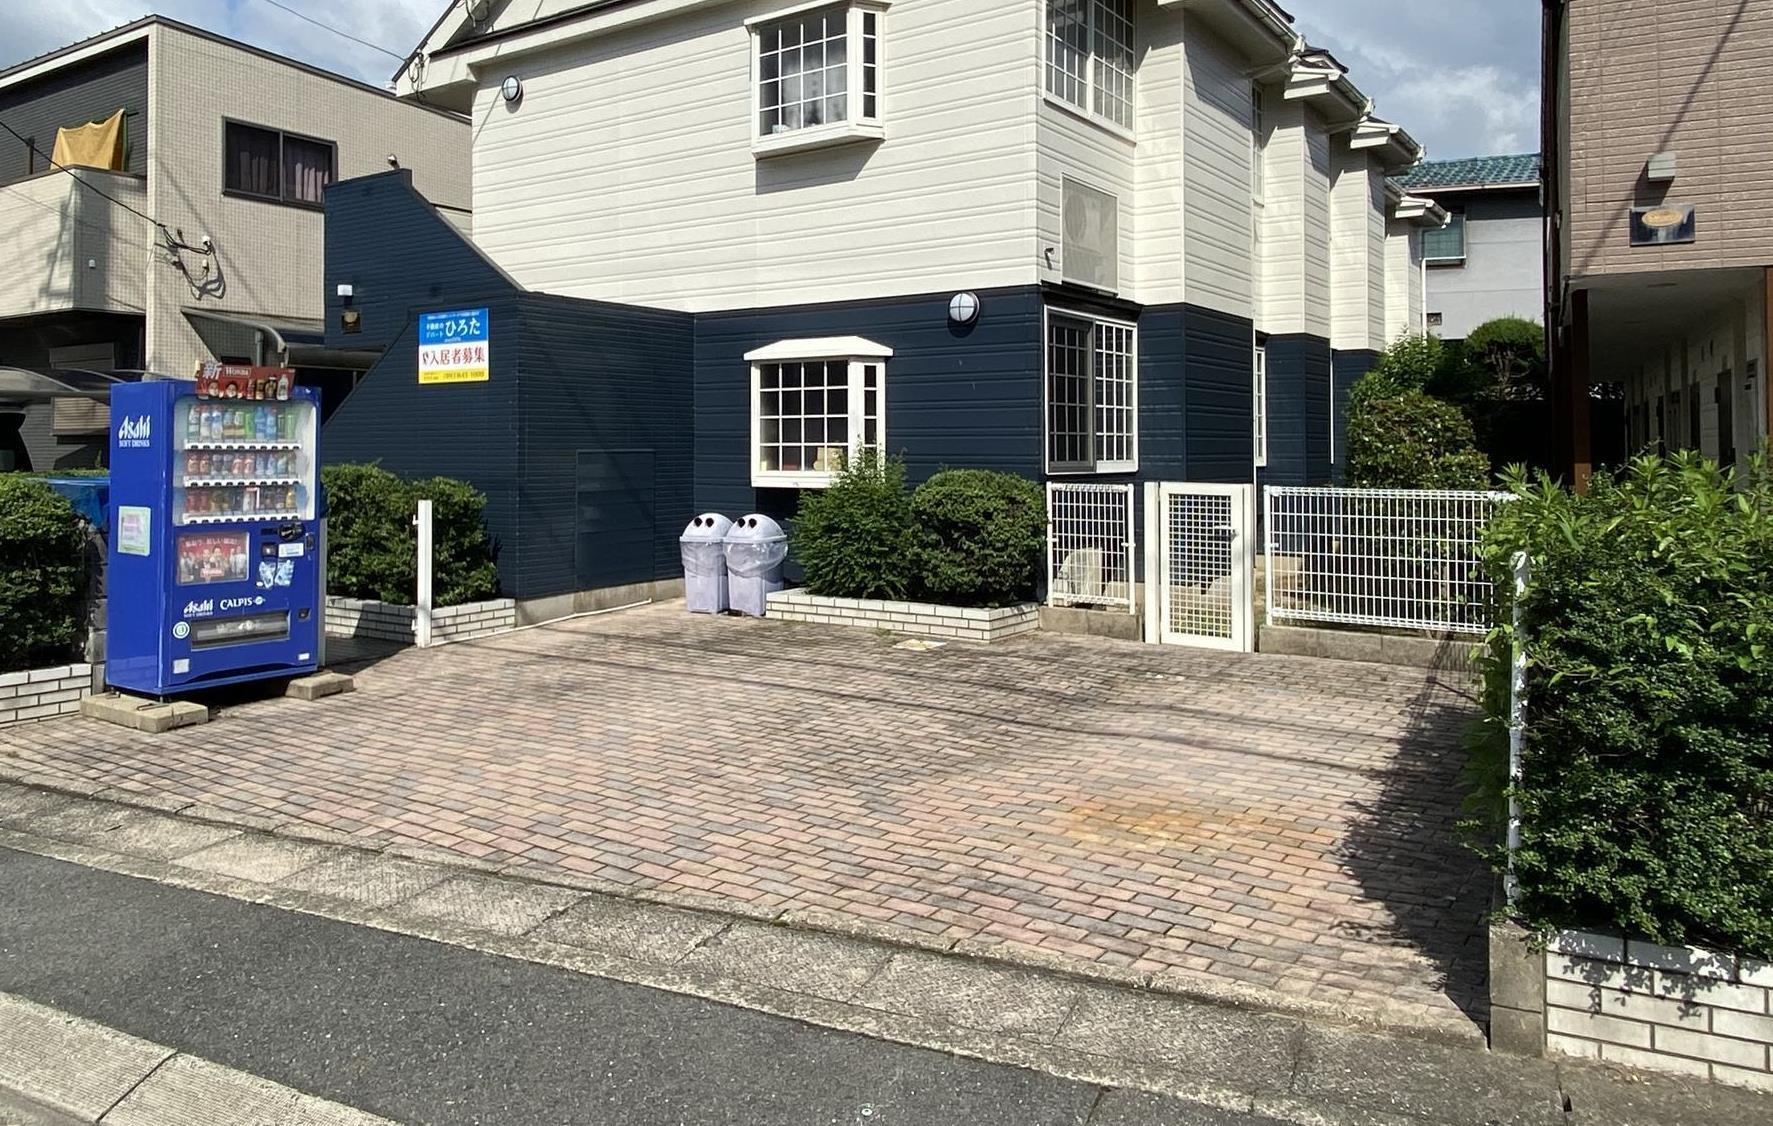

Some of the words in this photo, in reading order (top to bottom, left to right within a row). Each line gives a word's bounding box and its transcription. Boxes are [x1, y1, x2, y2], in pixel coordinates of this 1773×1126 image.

[445, 318, 480, 336] ひろた
[430, 347, 485, 365] 入居者募集
[203, 361, 222, 379] 新
[118, 415, 151, 439] Asahi
[183, 599, 213, 614] Asahi
[220, 597, 252, 610] CALPIS
